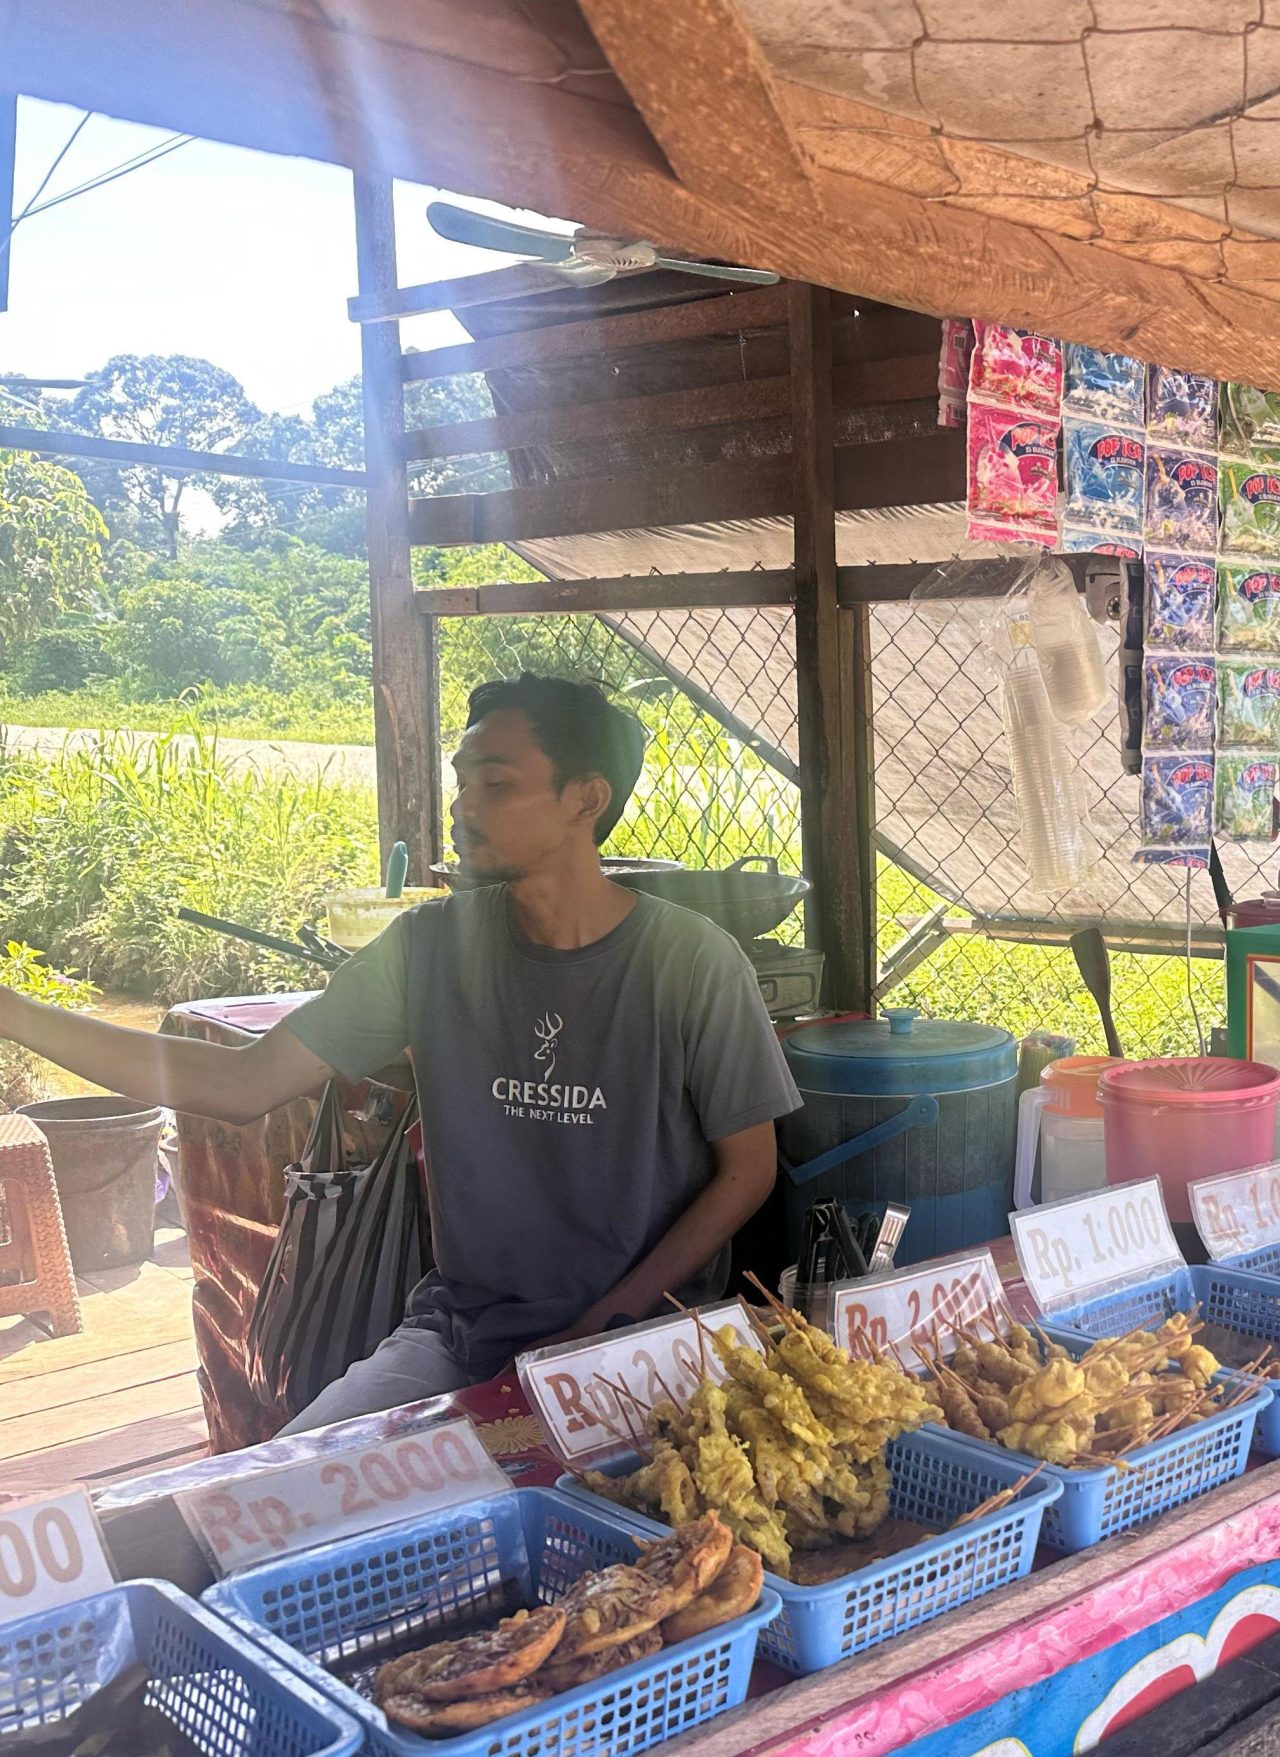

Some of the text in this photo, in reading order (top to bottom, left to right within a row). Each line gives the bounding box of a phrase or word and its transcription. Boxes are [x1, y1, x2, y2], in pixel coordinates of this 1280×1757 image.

[1097, 437, 1120, 462] POP
[1177, 463, 1199, 485] POP
[1246, 477, 1264, 498] POP
[492, 1077, 608, 1109] CRESSIDA
[503, 1104, 595, 1125] THE NEXT LEVEL
[1201, 1194, 1249, 1250] Rp.
[1026, 1195, 1162, 1289] Rp. 1.000
[201, 1430, 479, 1553] Rp. 2000
